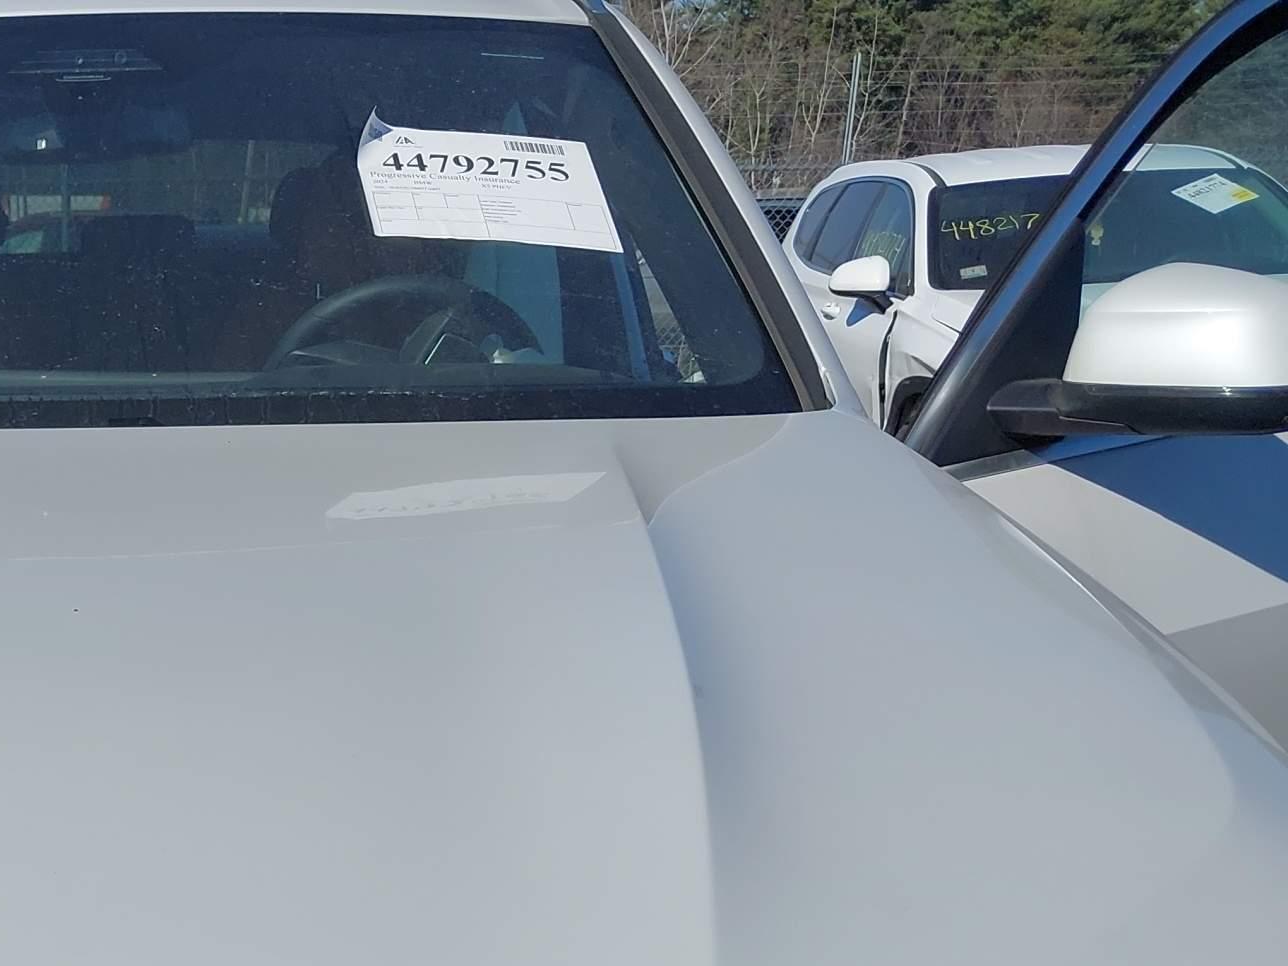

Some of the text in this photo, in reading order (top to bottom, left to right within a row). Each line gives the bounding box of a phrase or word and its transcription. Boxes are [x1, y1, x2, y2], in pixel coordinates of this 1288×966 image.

[369, 171, 521, 184] Progressive Casualty Insurance
[382, 152, 570, 182] 44792755
[941, 213, 1041, 241] 448217
